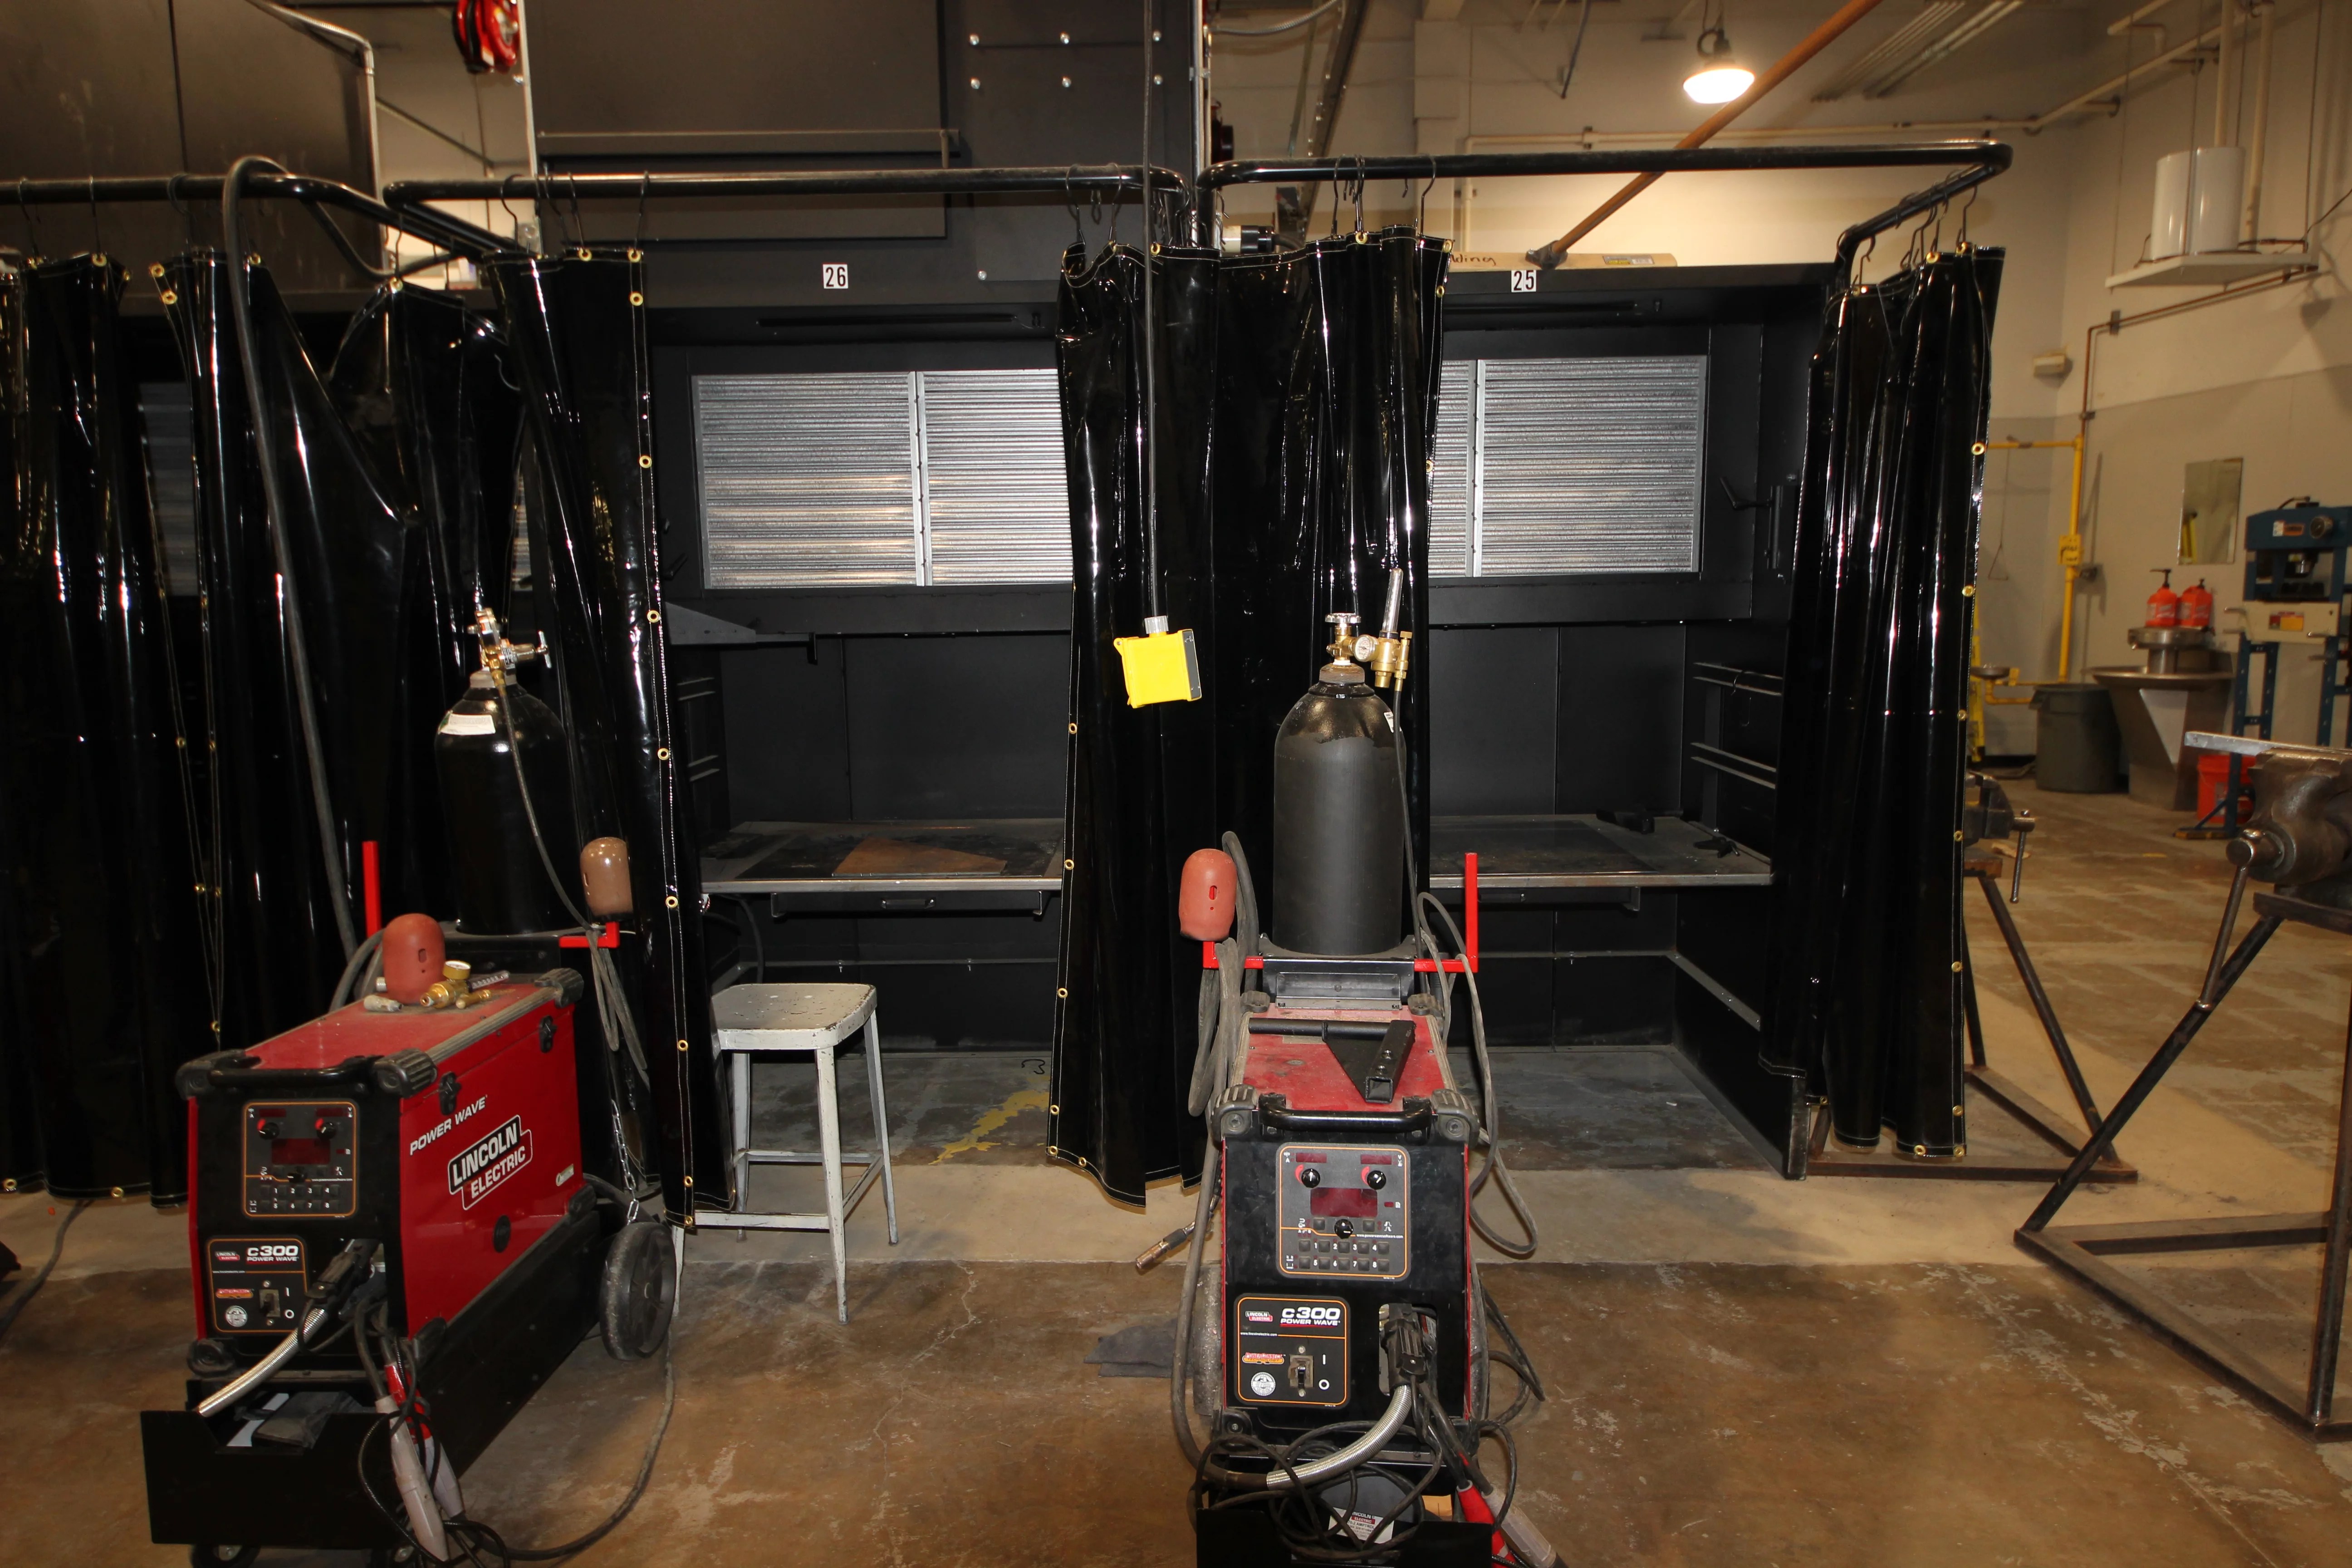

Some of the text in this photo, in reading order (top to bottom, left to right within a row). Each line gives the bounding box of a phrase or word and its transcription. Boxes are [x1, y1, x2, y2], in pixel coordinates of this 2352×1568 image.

[1452, 254, 1496, 266] lding
[826, 266, 846, 287] 26
[1514, 270, 1534, 291] 25
[410, 1096, 485, 1156] POWER WAVE
[452, 1122, 518, 1186] LINCOLN
[471, 1146, 526, 1199] ELECTRIC
[248, 1245, 299, 1256] c300
[1282, 1307, 1341, 1320] c300
